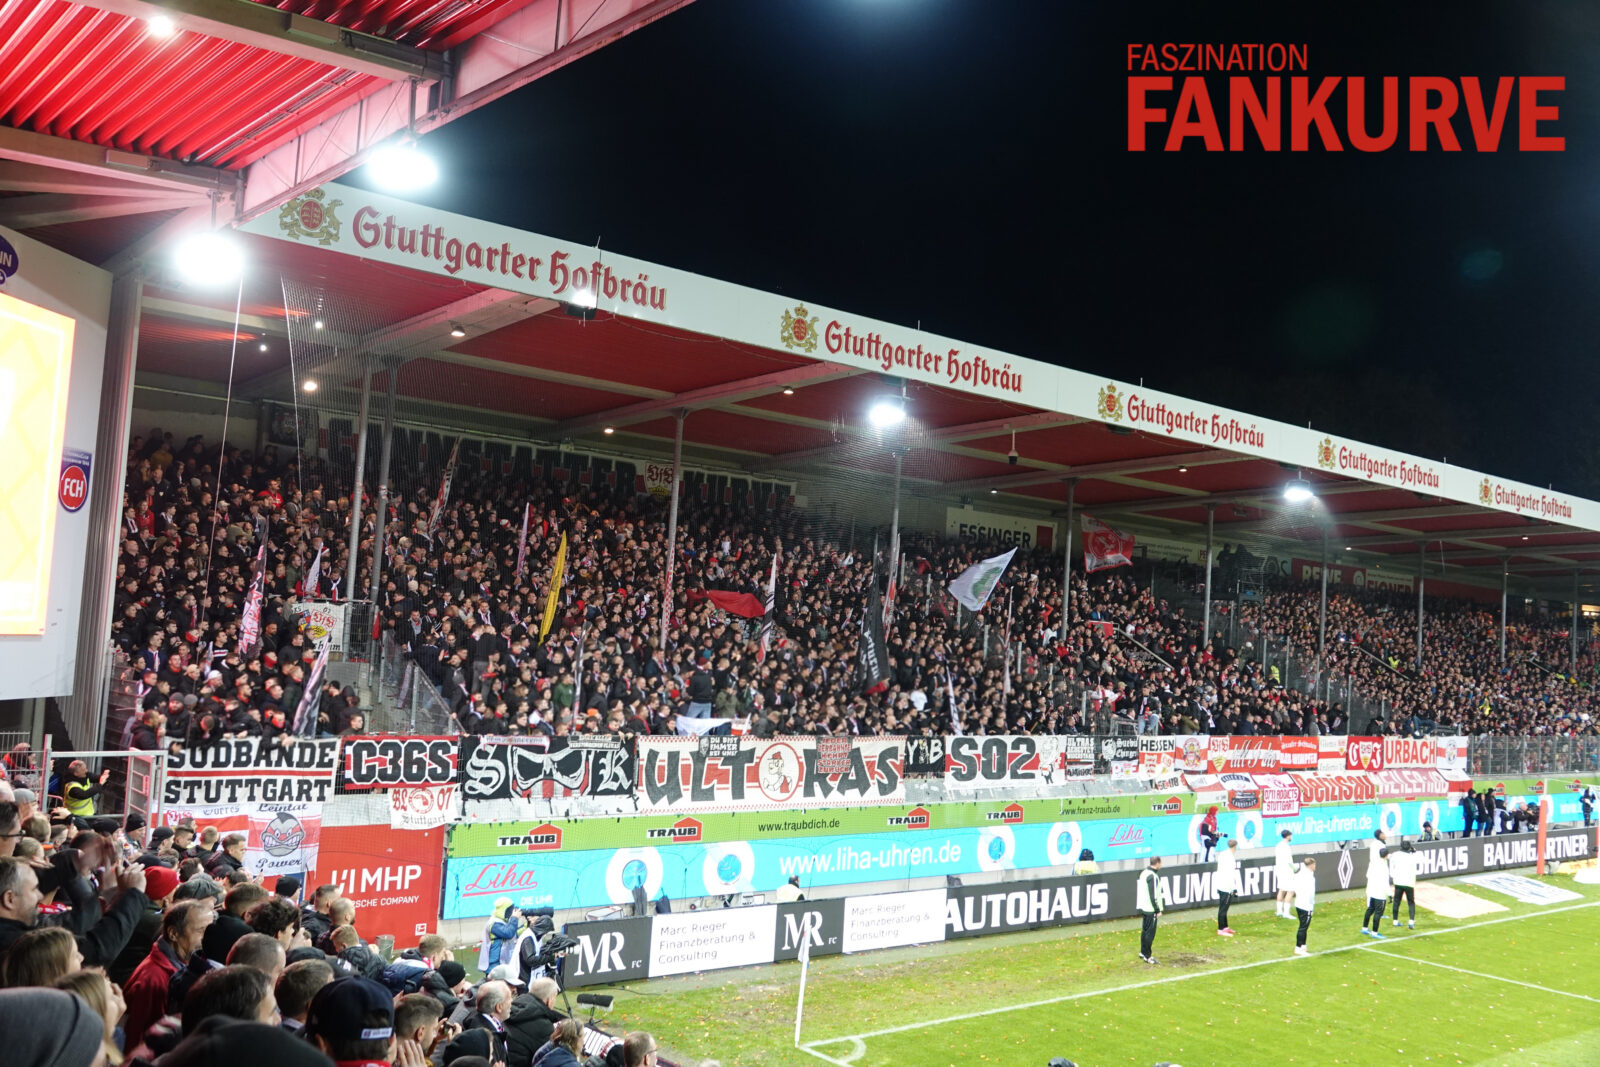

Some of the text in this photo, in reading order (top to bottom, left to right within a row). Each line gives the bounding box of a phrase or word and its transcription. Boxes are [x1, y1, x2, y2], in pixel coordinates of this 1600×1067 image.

[352, 205, 668, 311] Stuttgarter Hofbräu
[824, 320, 1022, 393] Stuttgarter Hofbräu
[1127, 394, 1265, 448] Stuttgarter Hofbräu
[1339, 446, 1440, 488] Stuttgarter Hofbräu
[63, 477, 84, 498] FCH
[1495, 486, 1573, 519] Stuttgarter Hofbräu
[959, 523, 1031, 549] ESSINGER
[1140, 739, 1175, 751] HESSEN
[1385, 739, 1436, 765] URBACH
[164, 779, 332, 804] STUTTGART
[987, 811, 1020, 820] TRAUB
[1152, 803, 1179, 811] TRAUB
[757, 819, 840, 832] www.traubdich.de
[888, 816, 926, 826] TRAUB
[499, 835, 556, 846] TRAUB
[648, 827, 697, 837] TRAUB
[1109, 824, 1144, 843] Liha
[780, 840, 961, 875] www.liha-uhren.de
[361, 865, 422, 893] MHP
[464, 863, 538, 892] Liha
[351, 896, 419, 909] RSCHE COMPANY
[945, 882, 1108, 933] AUTOHAUS
[660, 921, 728, 937] Marc Rieger
[660, 931, 757, 950] Finanzberatung &
[828, 937, 837, 945] FC
[574, 931, 642, 976] MR FC
[658, 949, 718, 965] Consulting
